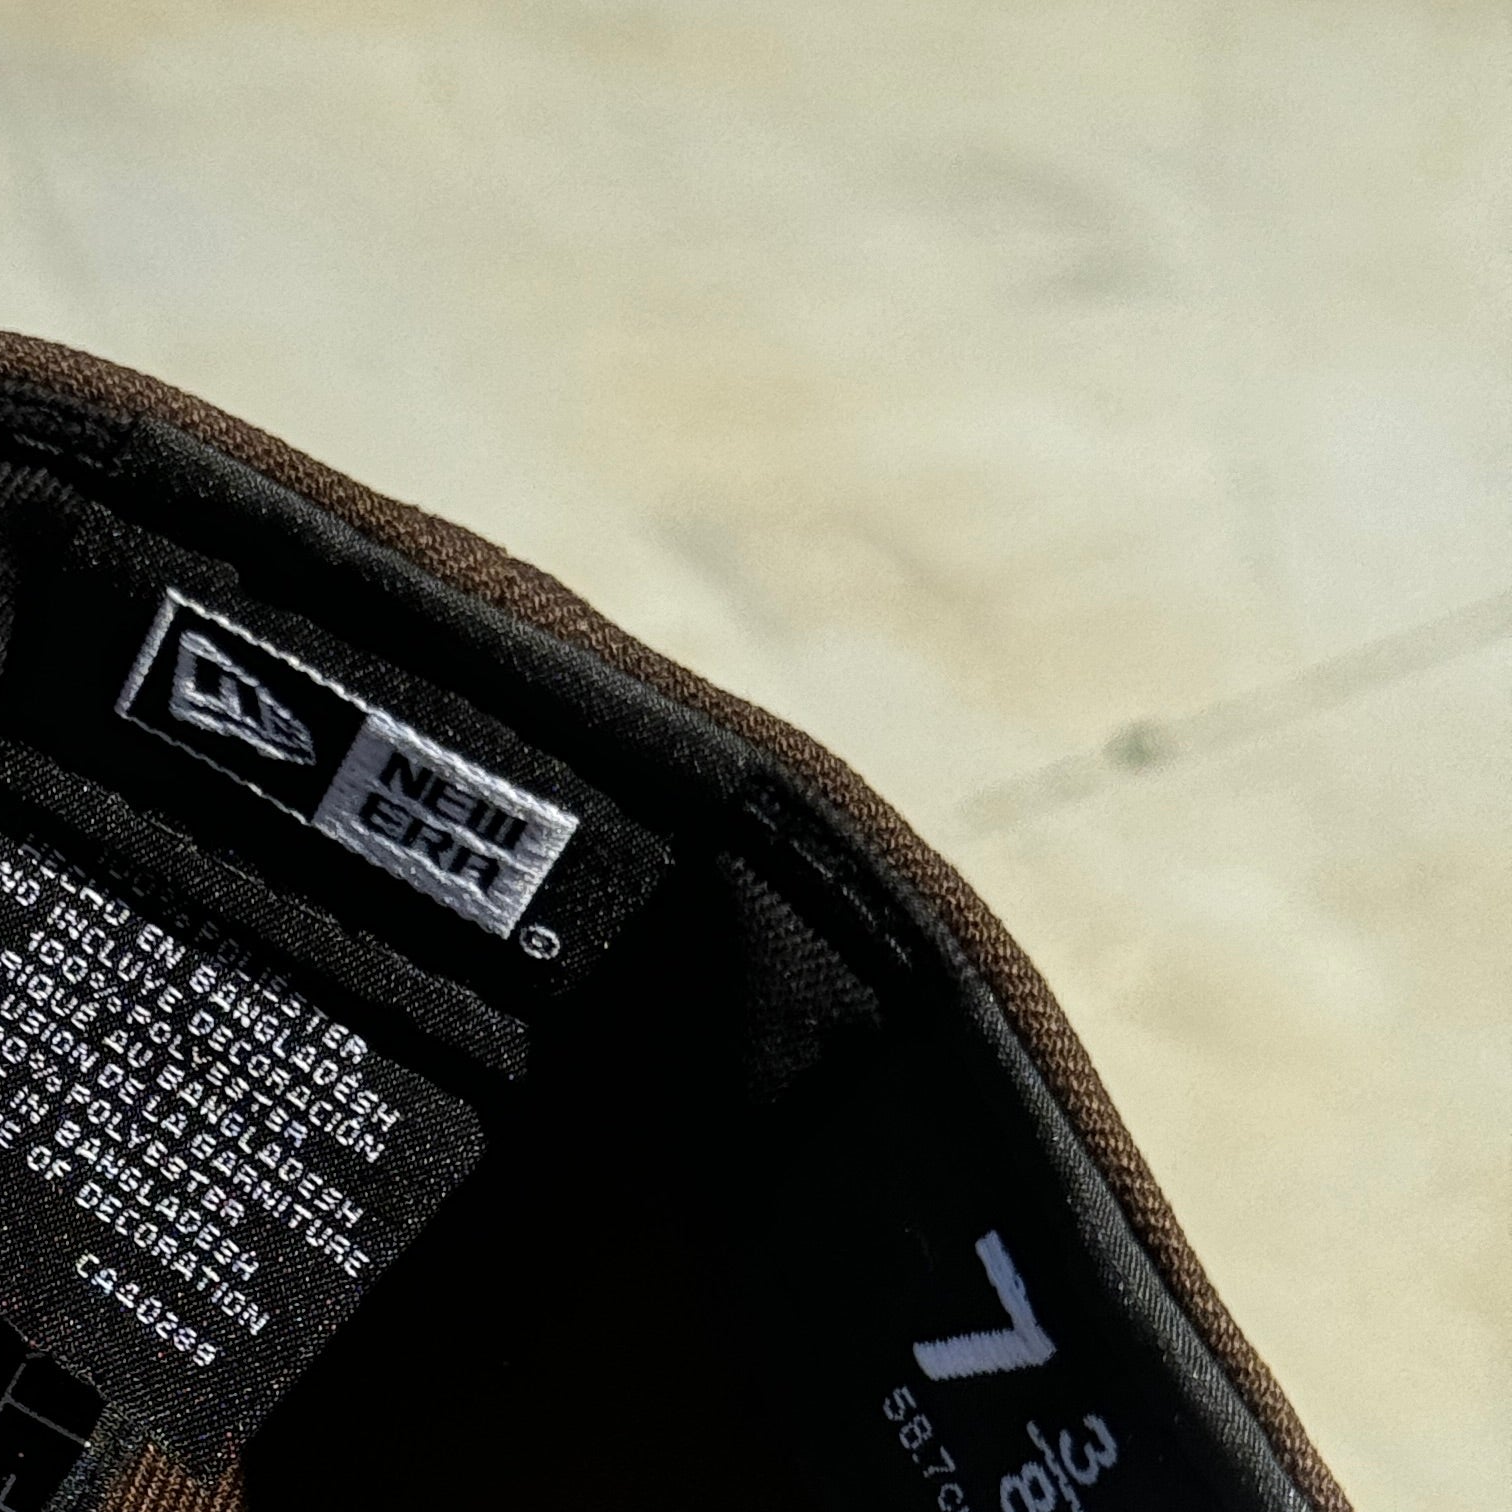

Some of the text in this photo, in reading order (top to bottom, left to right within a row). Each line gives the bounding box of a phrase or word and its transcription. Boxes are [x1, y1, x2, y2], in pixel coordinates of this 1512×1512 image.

[359, 793, 504, 889] ERA
[379, 752, 528, 852] NEW
[46, 901, 184, 1013] INCLUYE
[135, 922, 184, 968] EN
[9, 1085, 51, 1124] IN
[53, 1118, 260, 1281] BANGLADESH
[96, 1062, 143, 1104] DE
[141, 1095, 190, 1139] LA
[187, 1130, 369, 1277] GARNITURE
[101, 1024, 152, 1071] AU
[155, 1063, 364, 1228] BANGLADESH
[24, 1143, 70, 1186] OF
[75, 1180, 269, 1335] DECORATION
[913, 1229, 1058, 1381] 7
